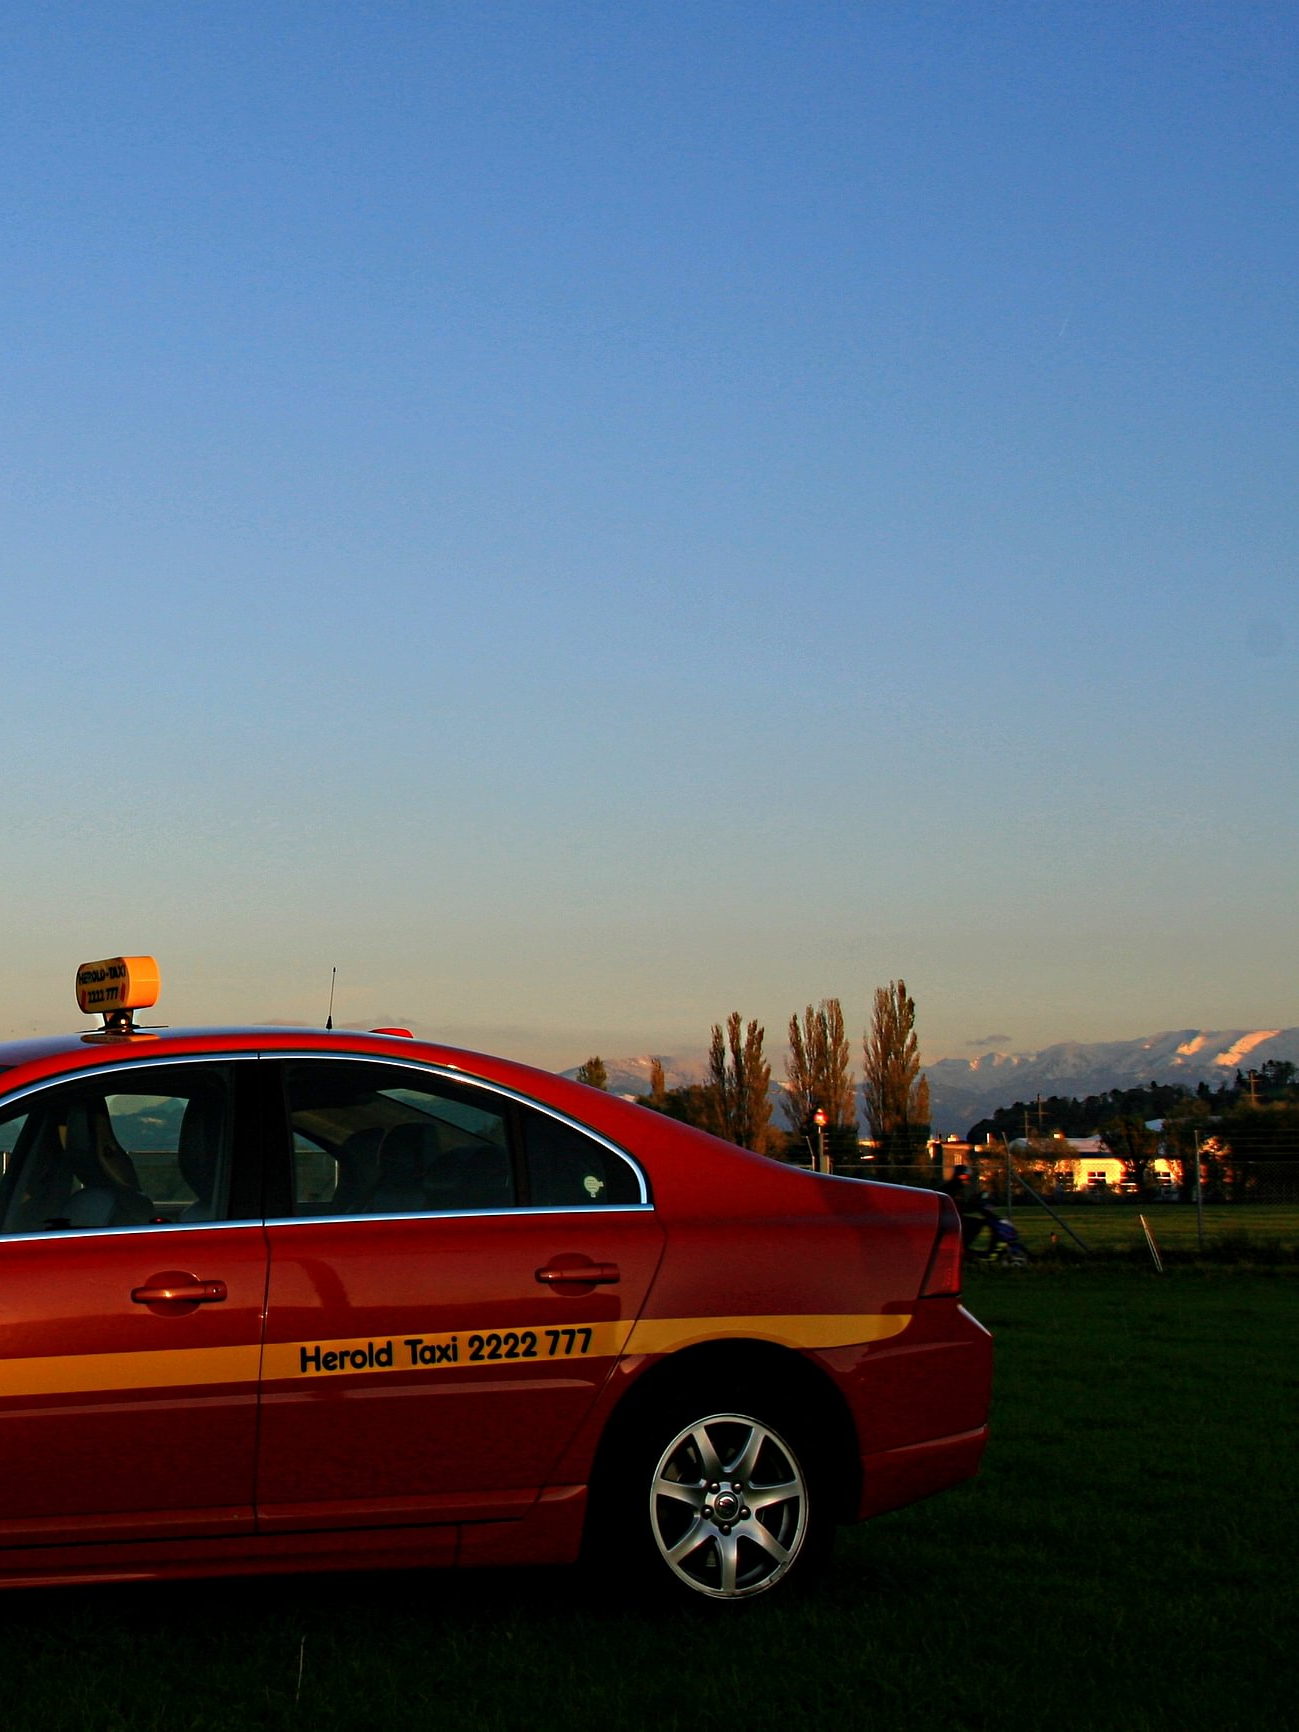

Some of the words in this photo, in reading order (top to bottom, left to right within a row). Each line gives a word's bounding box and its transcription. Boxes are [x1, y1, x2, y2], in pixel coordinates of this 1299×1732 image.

[106, 987, 119, 1000] 777
[300, 1341, 393, 1373] Herold
[404, 1336, 458, 1365] Taxi
[468, 1331, 538, 1361] 2222
[545, 1328, 592, 1356] 777
